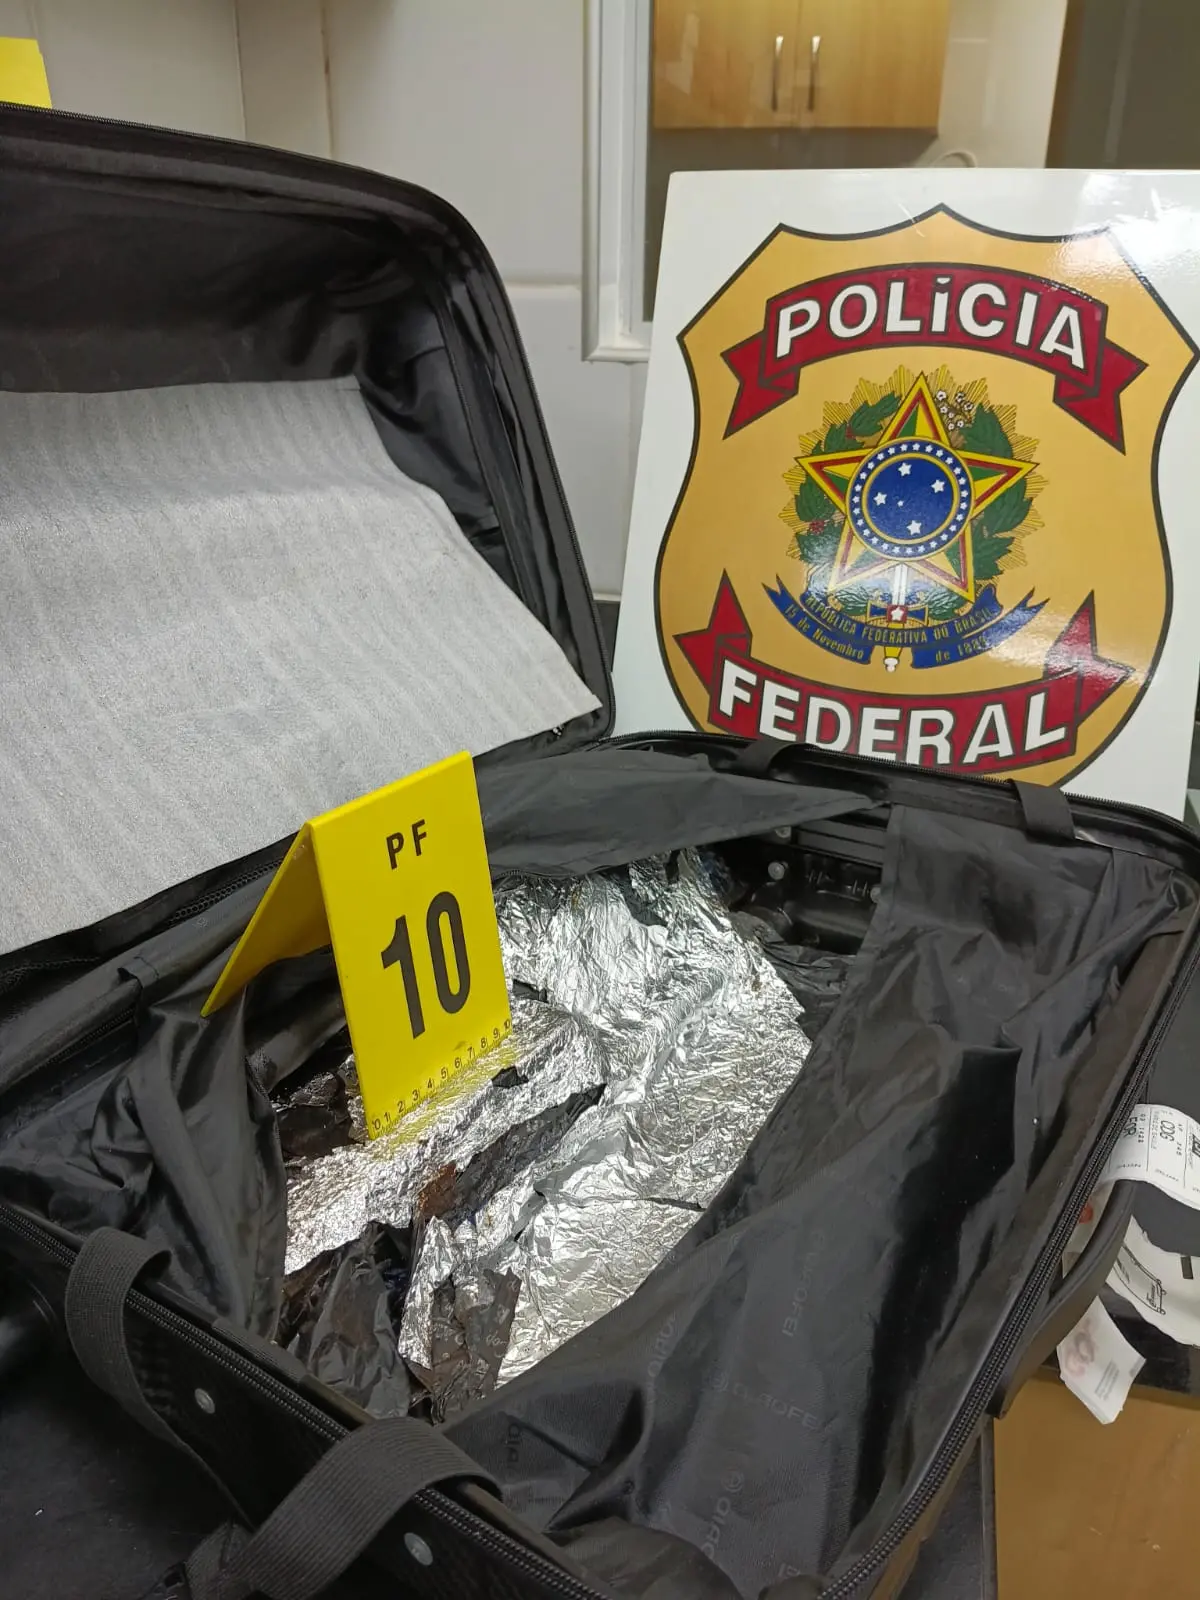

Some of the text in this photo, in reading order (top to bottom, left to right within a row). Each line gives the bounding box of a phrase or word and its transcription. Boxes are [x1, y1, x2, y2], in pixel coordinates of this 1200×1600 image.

[797, 616, 811, 633] de
[812, 627, 865, 660] Novembro
[935, 650, 951, 663] de
[861, 625, 928, 643] FEDERATIVA
[933, 623, 949, 640] DO
[954, 607, 994, 634] BRASIL
[719, 659, 1065, 765] FEDERAL
[386, 819, 428, 870] PF
[380, 891, 471, 1040] 10
[397, 1100, 404, 1113] 2
[412, 1089, 419, 1101] 3
[427, 1078, 433, 1089] 4
[440, 1066, 447, 1079] 5
[454, 1057, 461, 1069] 6
[467, 1046, 473, 1058] 7
[480, 1037, 486, 1049] 8
[493, 1027, 499, 1039] 9
